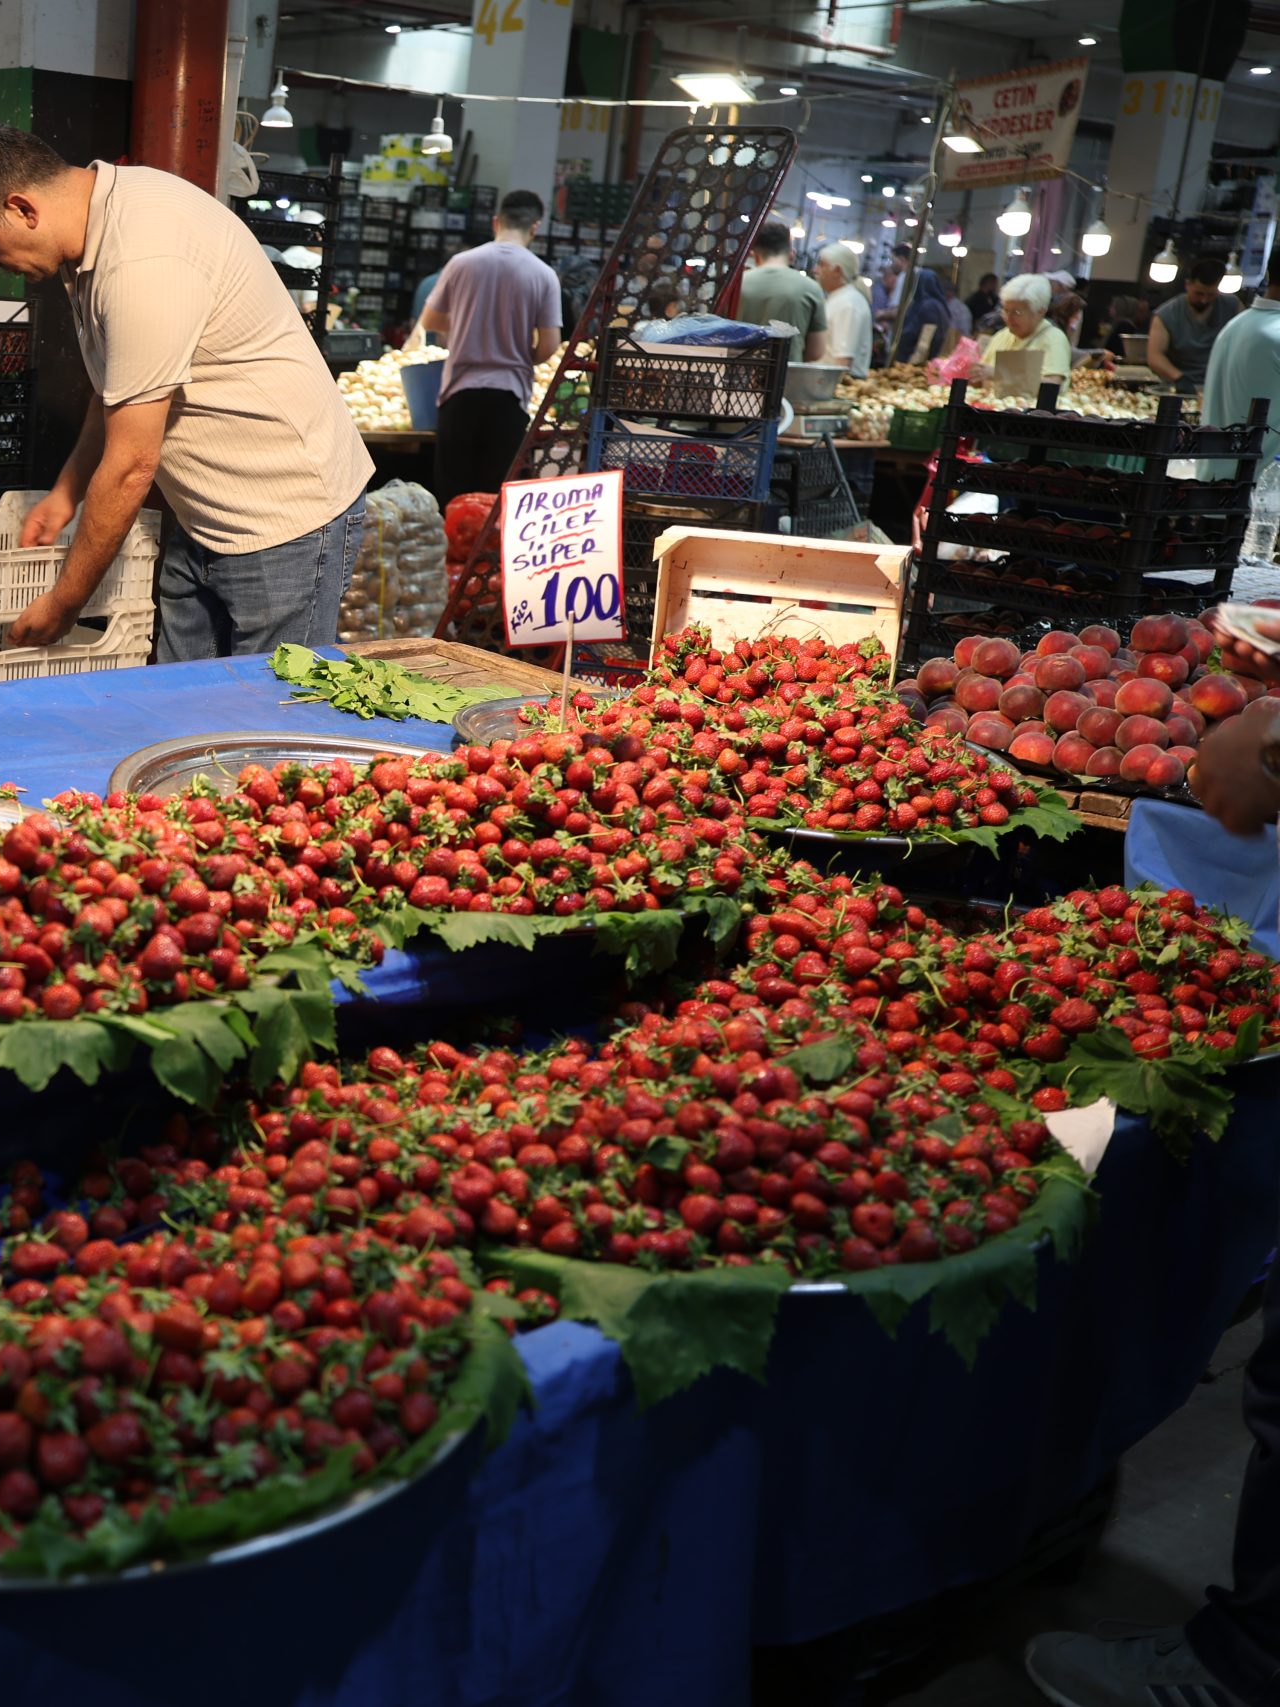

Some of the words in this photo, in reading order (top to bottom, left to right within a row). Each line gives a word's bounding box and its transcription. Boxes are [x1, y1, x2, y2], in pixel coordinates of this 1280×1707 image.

[1123, 80, 1167, 115] 31
[514, 483, 604, 520] AROMA
[533, 572, 620, 631] 100
